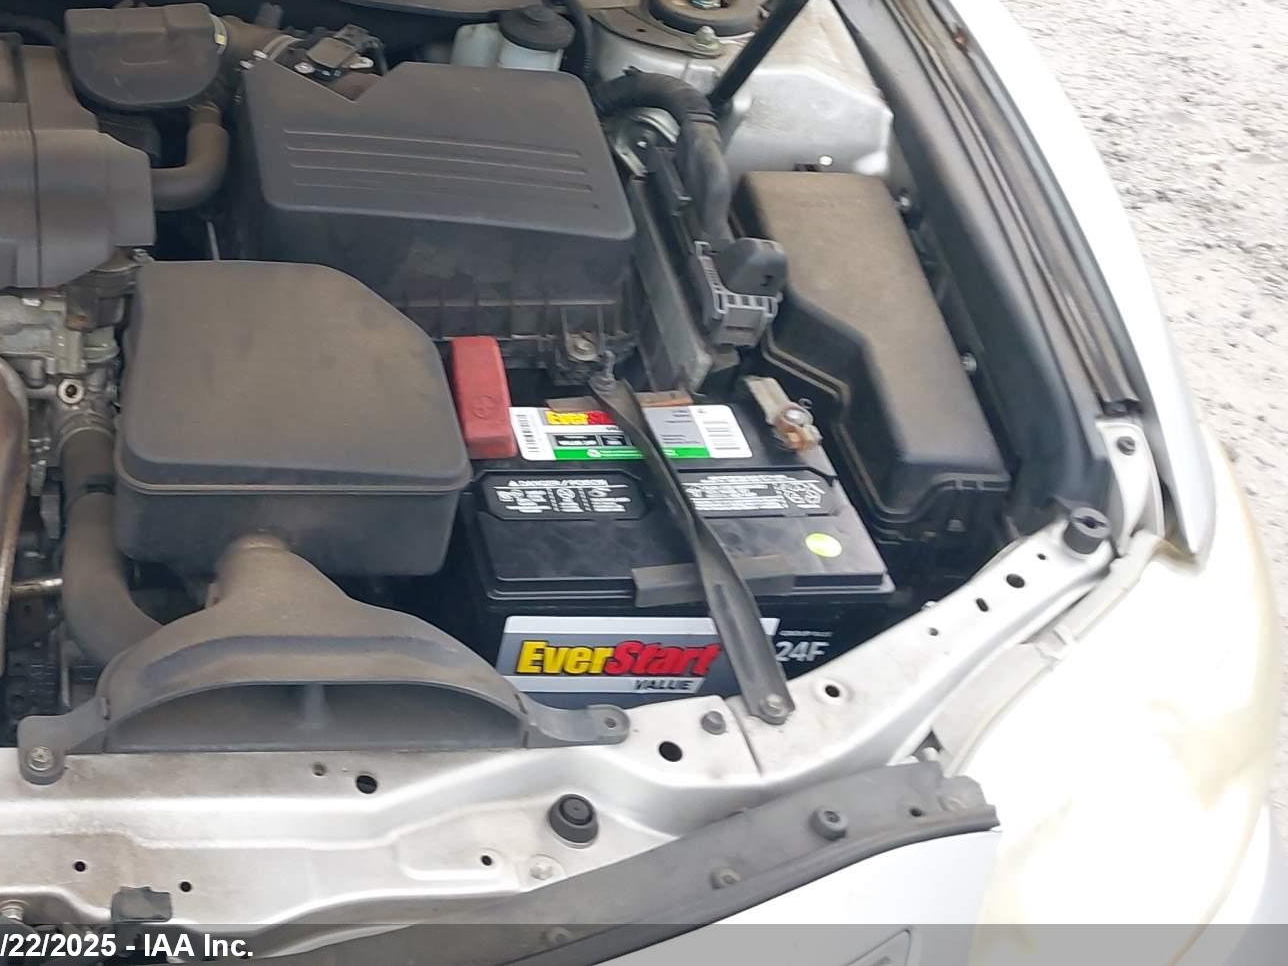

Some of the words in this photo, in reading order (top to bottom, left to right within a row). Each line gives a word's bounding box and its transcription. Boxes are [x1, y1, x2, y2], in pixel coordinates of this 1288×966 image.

[516, 640, 722, 676] EverStart
[775, 640, 830, 662] 24F
[633, 678, 694, 691] VALUE
